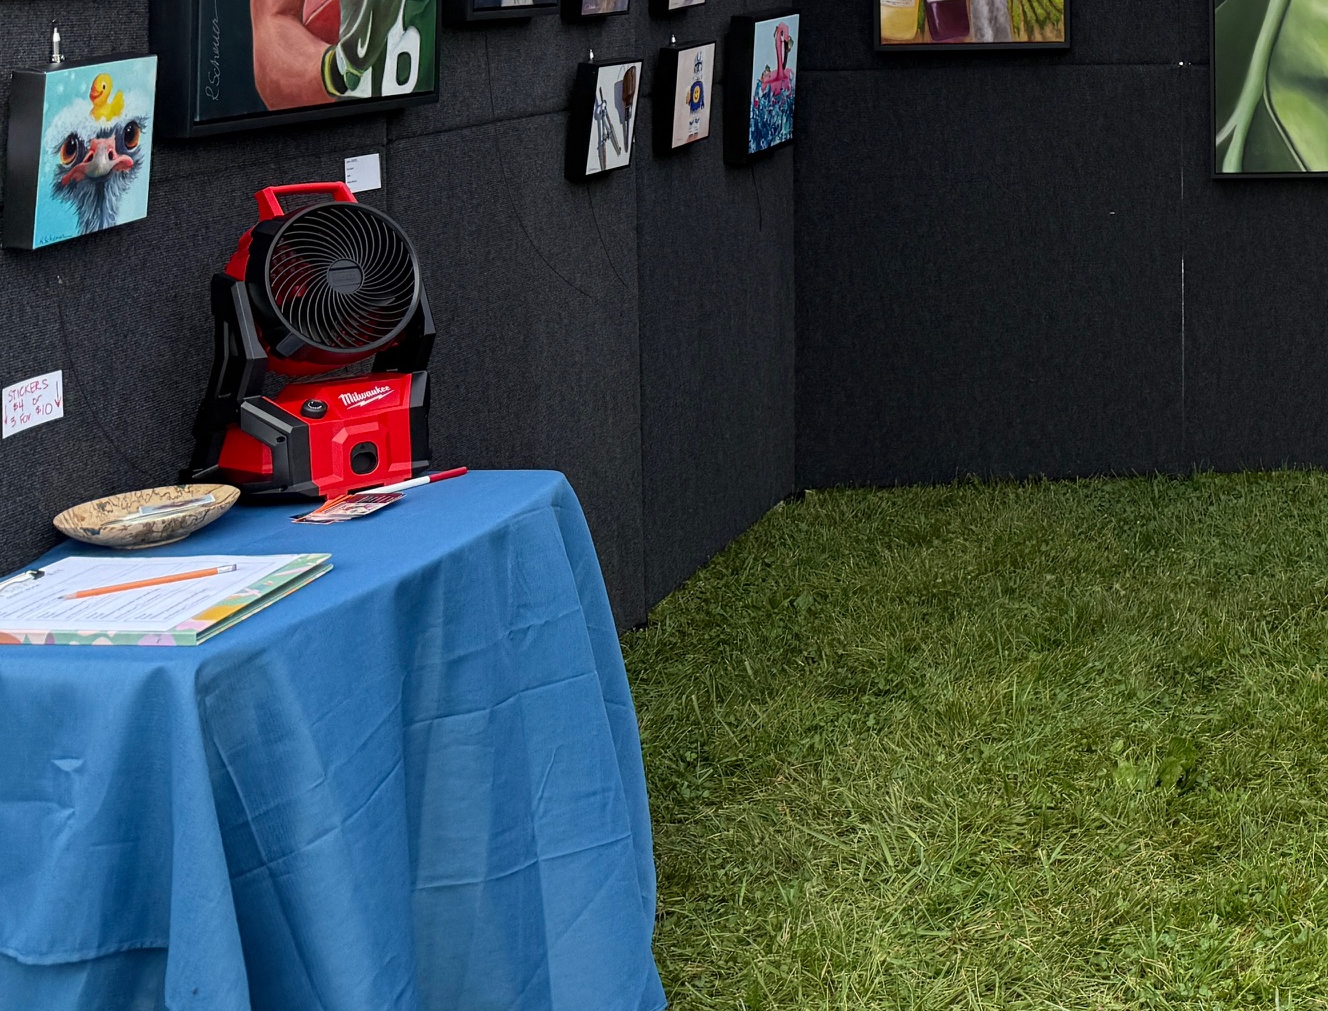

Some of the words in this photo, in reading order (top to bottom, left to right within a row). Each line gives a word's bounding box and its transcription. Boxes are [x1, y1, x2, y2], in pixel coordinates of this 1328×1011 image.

[8, 378, 49, 403] STICKERS
[338, 385, 391, 406] Milwaukee
[10, 416, 17, 428] 3
[35, 402, 53, 416] $10
